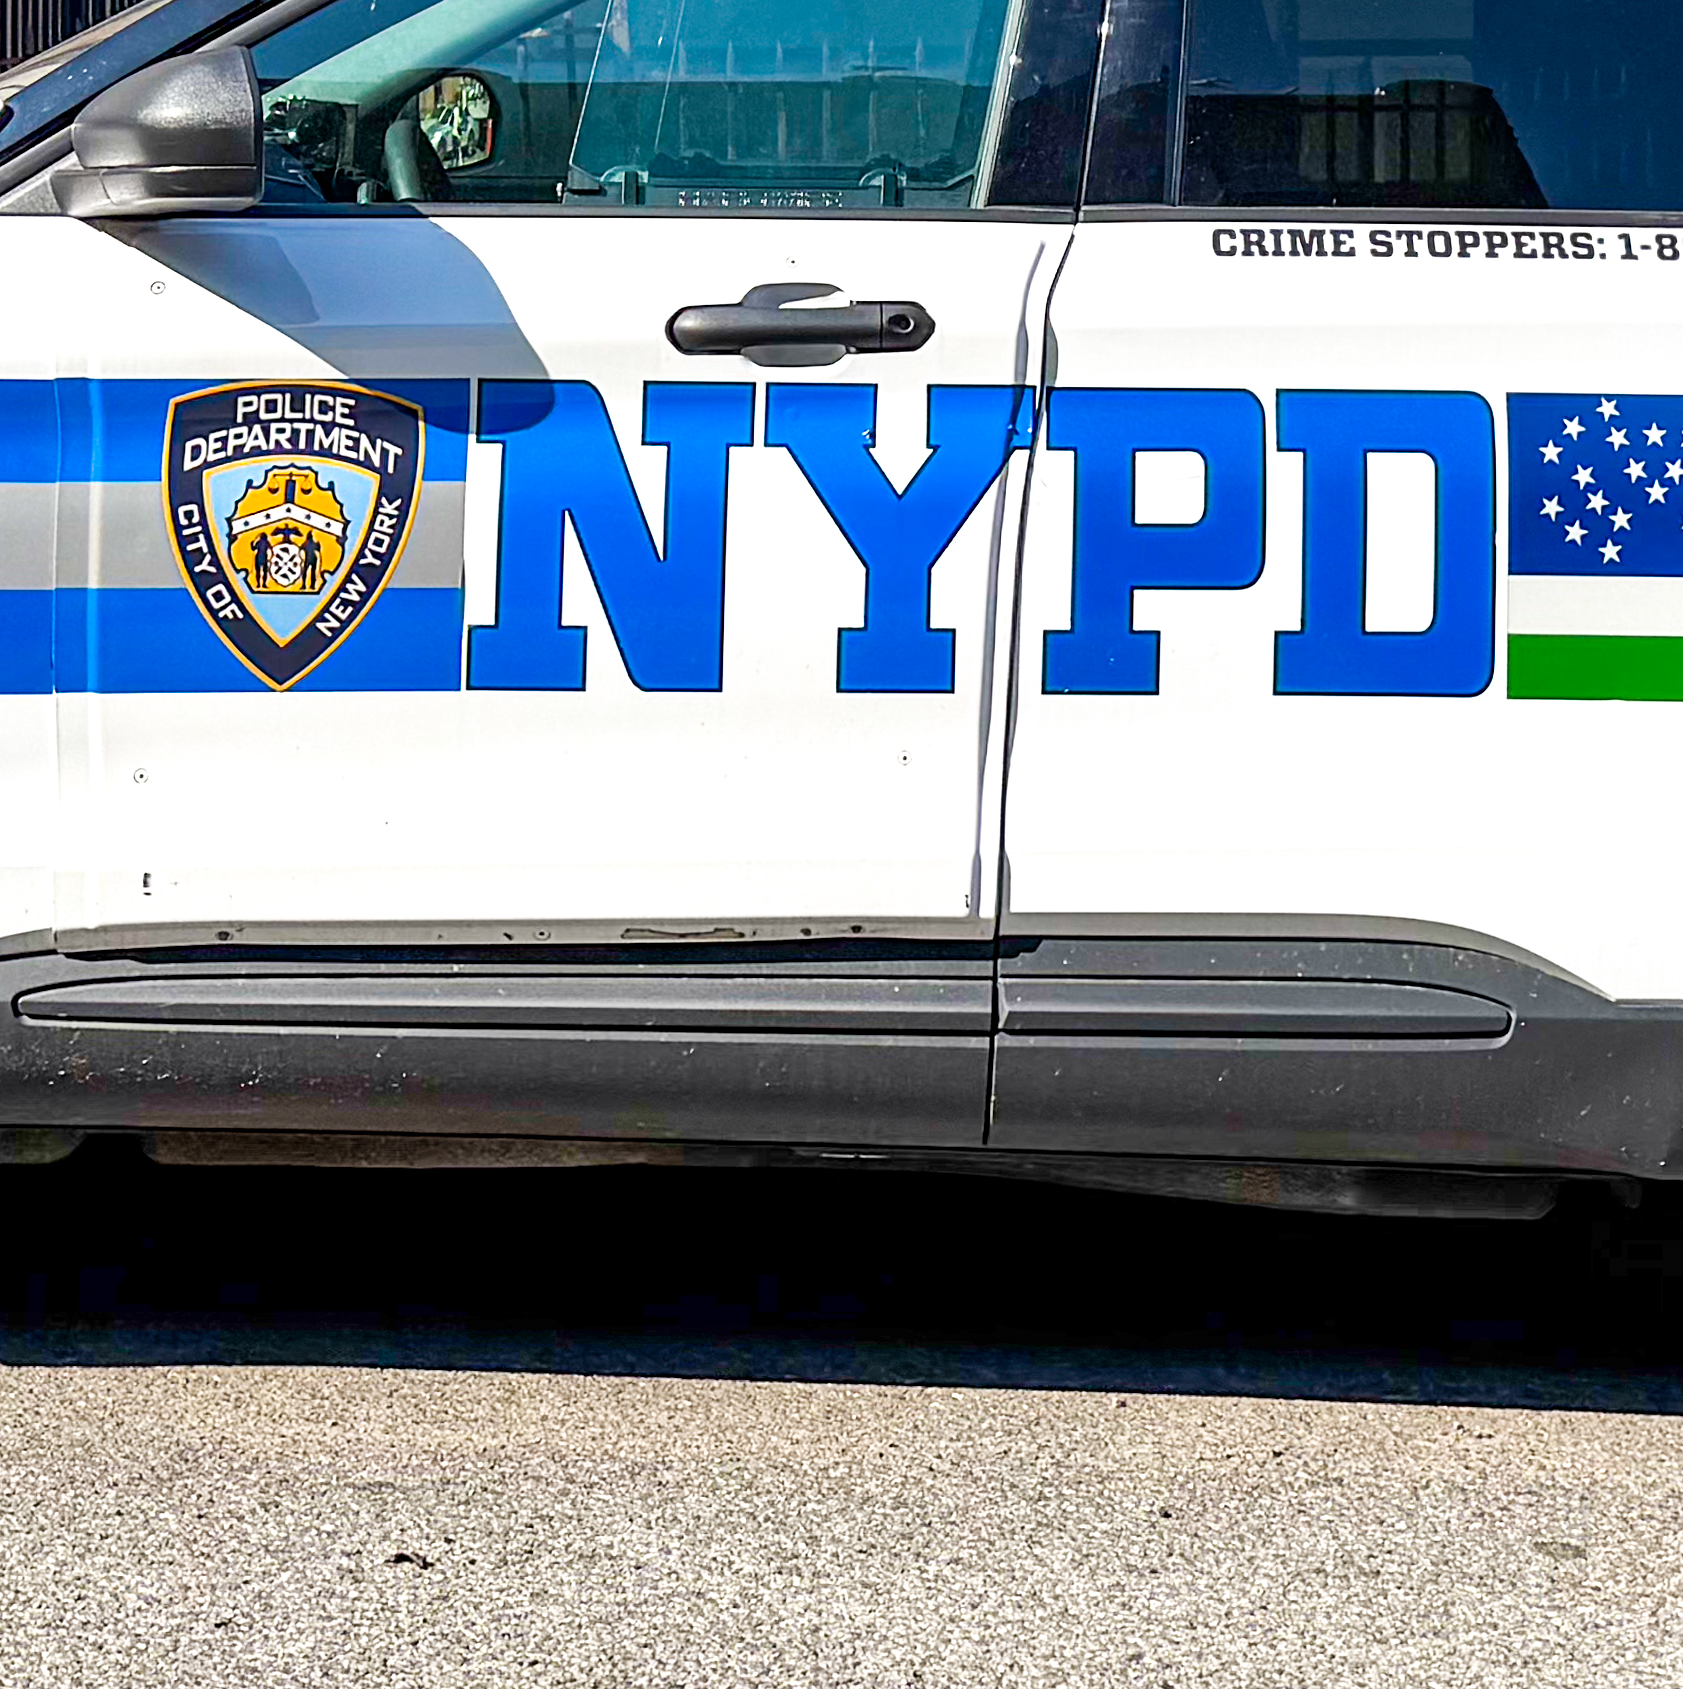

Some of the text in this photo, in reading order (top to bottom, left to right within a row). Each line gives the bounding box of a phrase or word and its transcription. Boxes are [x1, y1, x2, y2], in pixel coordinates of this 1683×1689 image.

[1212, 228, 1356, 258] CRIME
[1368, 229, 1607, 260] STOPPERS:
[183, 422, 403, 474] DEPARTMENT
[236, 393, 356, 426] POLICE
[178, 503, 243, 621] CITY OF
[316, 496, 402, 637] NEW YORK
[466, 379, 1495, 697] NYPD
